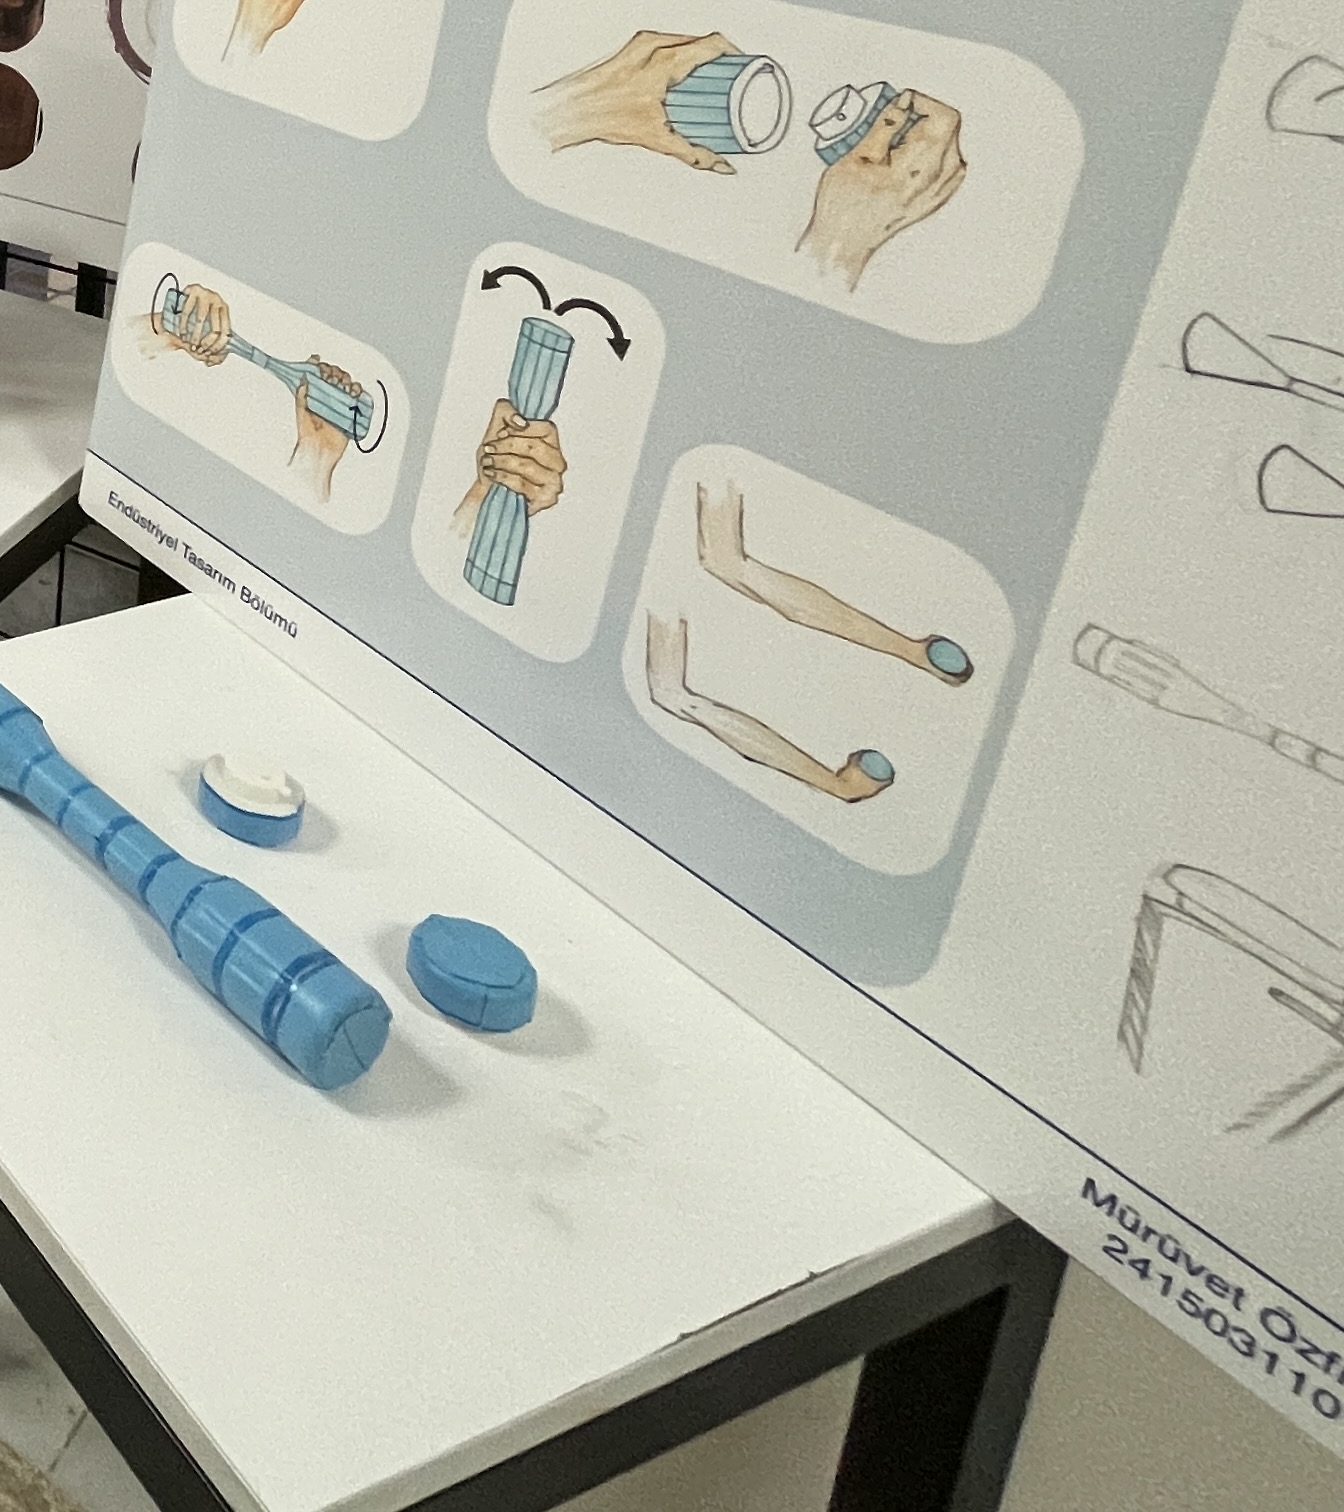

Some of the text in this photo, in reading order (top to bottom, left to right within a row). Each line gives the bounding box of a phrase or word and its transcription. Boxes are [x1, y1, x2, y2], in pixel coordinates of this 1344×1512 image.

[107, 490, 299, 639] Endüstriyel Tasarım Bölümü
[1080, 1176, 1246, 1312] Mürüvet
[1101, 1233, 1343, 1420] 241503110
